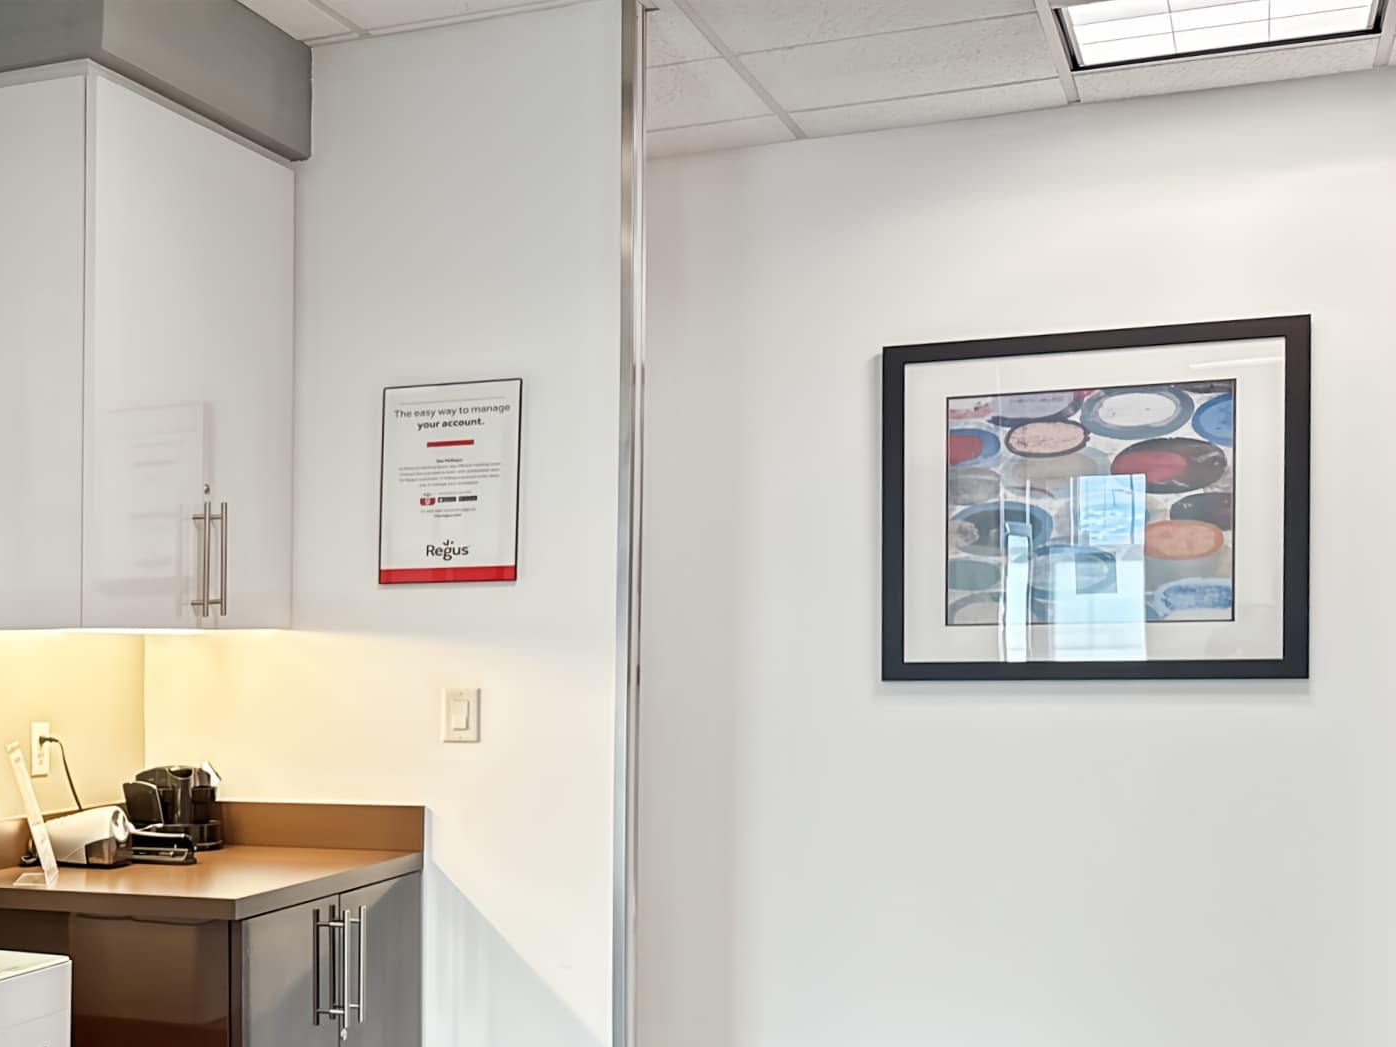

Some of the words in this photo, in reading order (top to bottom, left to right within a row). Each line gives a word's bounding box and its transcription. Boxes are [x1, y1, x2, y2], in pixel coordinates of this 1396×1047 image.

[394, 409, 412, 418] The
[414, 410, 436, 419] easy
[438, 408, 457, 417] way
[459, 406, 469, 414] to
[471, 404, 511, 414] manage
[417, 420, 440, 431] your
[442, 418, 485, 428] account.
[426, 544, 470, 561] Regus
